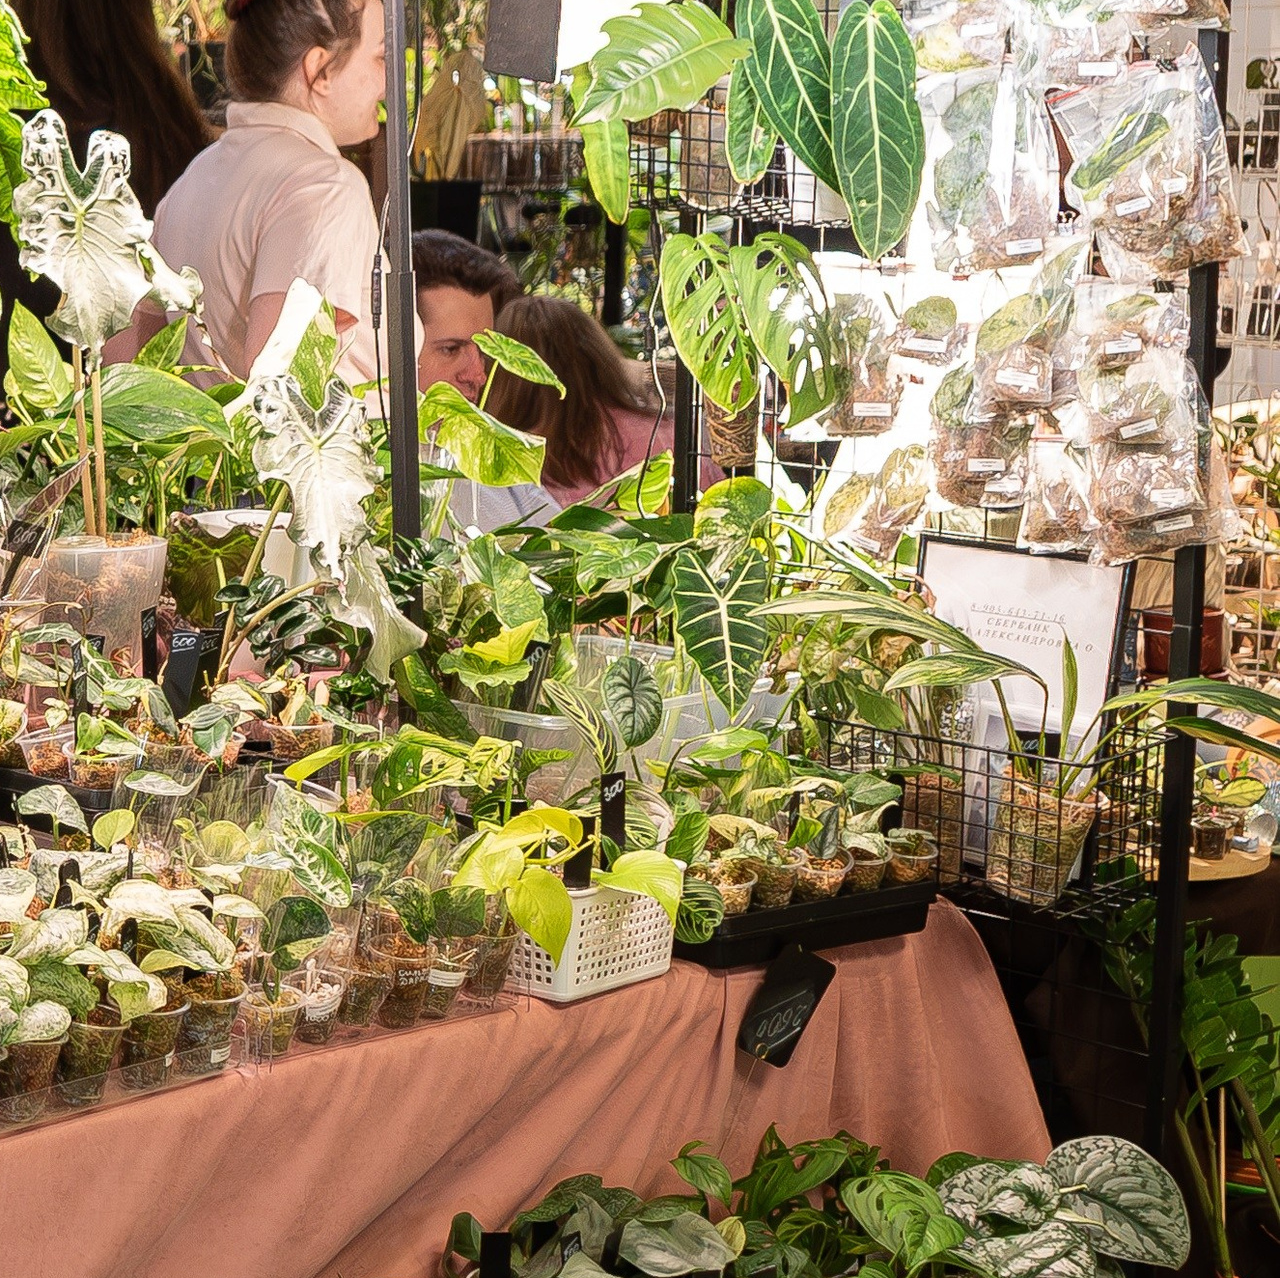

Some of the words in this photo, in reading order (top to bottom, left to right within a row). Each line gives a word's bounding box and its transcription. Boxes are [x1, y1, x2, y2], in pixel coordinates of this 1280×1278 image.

[986, 617, 1051, 634] СБЕРБАНК
[172, 636, 197, 648] 600
[974, 627, 1079, 651] АЛЕКСАНДРОВА
[603, 779, 624, 802] 300
